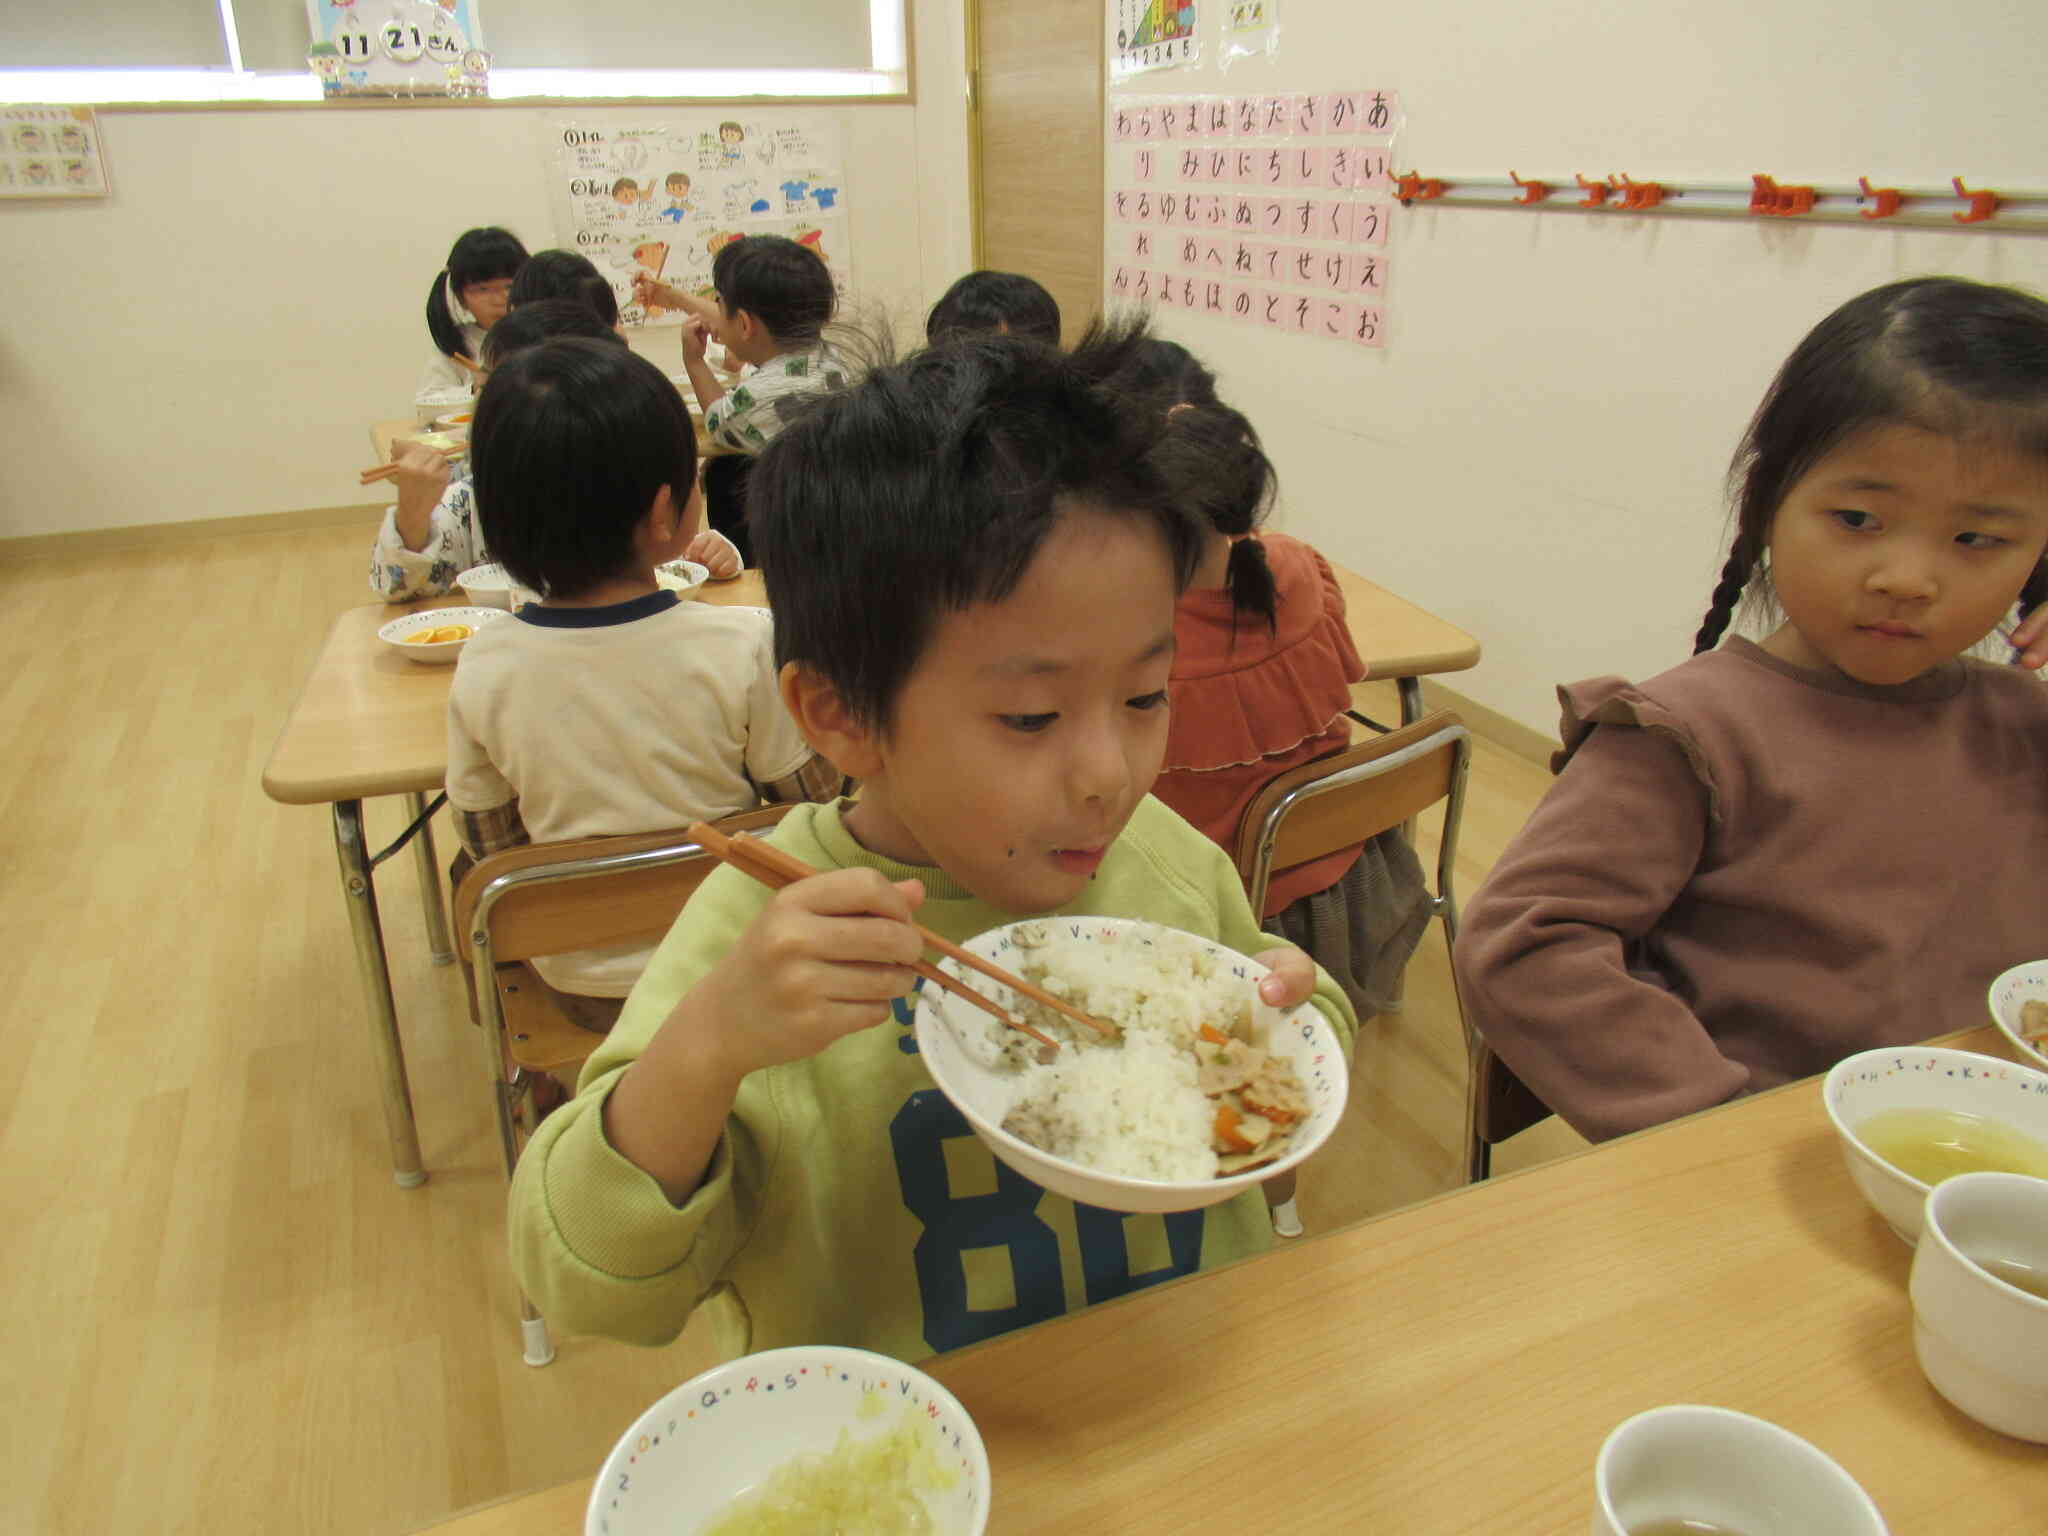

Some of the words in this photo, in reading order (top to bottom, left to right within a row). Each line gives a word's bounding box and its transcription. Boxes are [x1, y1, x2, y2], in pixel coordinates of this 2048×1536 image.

[341, 34, 369, 56] 11
[387, 26, 421, 49] 21
[1143, 47, 1150, 65] 2
[1154, 45, 1161, 62] 3
[1166, 42, 1173, 60] 4
[1183, 39, 1190, 57] 5
[1116, 111, 1132, 136] わ
[1161, 107, 1176, 138] や
[1185, 103, 1199, 133] ま
[1210, 103, 1227, 132] は
[1239, 100, 1256, 133] な
[1267, 99, 1284, 129] た
[1300, 96, 1315, 132] さ
[1332, 97, 1355, 128] か
[1367, 91, 1389, 129] あ
[1140, 151, 1152, 179] り
[1182, 149, 1200, 178] み
[1211, 151, 1225, 179] ひ
[1238, 151, 1251, 177] に
[1268, 149, 1281, 183] ち
[1301, 149, 1313, 179] し
[1332, 149, 1346, 187] き
[1364, 156, 1384, 180] い
[1137, 192, 1150, 219] る
[1160, 193, 1176, 223] ゆ
[1184, 193, 1200, 222] む
[1207, 196, 1227, 224] ふ
[1232, 201, 1253, 225] ぬ
[1266, 204, 1281, 226] つ
[1296, 200, 1314, 235] す
[1331, 203, 1341, 235] く
[1364, 205, 1379, 240] う
[1183, 237, 1200, 265] め
[1207, 247, 1223, 265] へ
[1234, 242, 1252, 273] ね
[1296, 251, 1313, 280] せ
[1326, 253, 1343, 287] け
[1360, 257, 1379, 288] え
[1137, 270, 1149, 300] ろ
[1159, 274, 1173, 303] よ
[1183, 279, 1195, 307] も
[1235, 291, 1251, 315] の
[1266, 295, 1280, 323] と
[1295, 297, 1310, 329] そ
[1326, 303, 1341, 334] こ
[1357, 309, 1379, 340] お
[701, 1390, 720, 1408] Q
[785, 1373, 798, 1390] S
[823, 1363, 834, 1379] T
[900, 1379, 911, 1395] V
